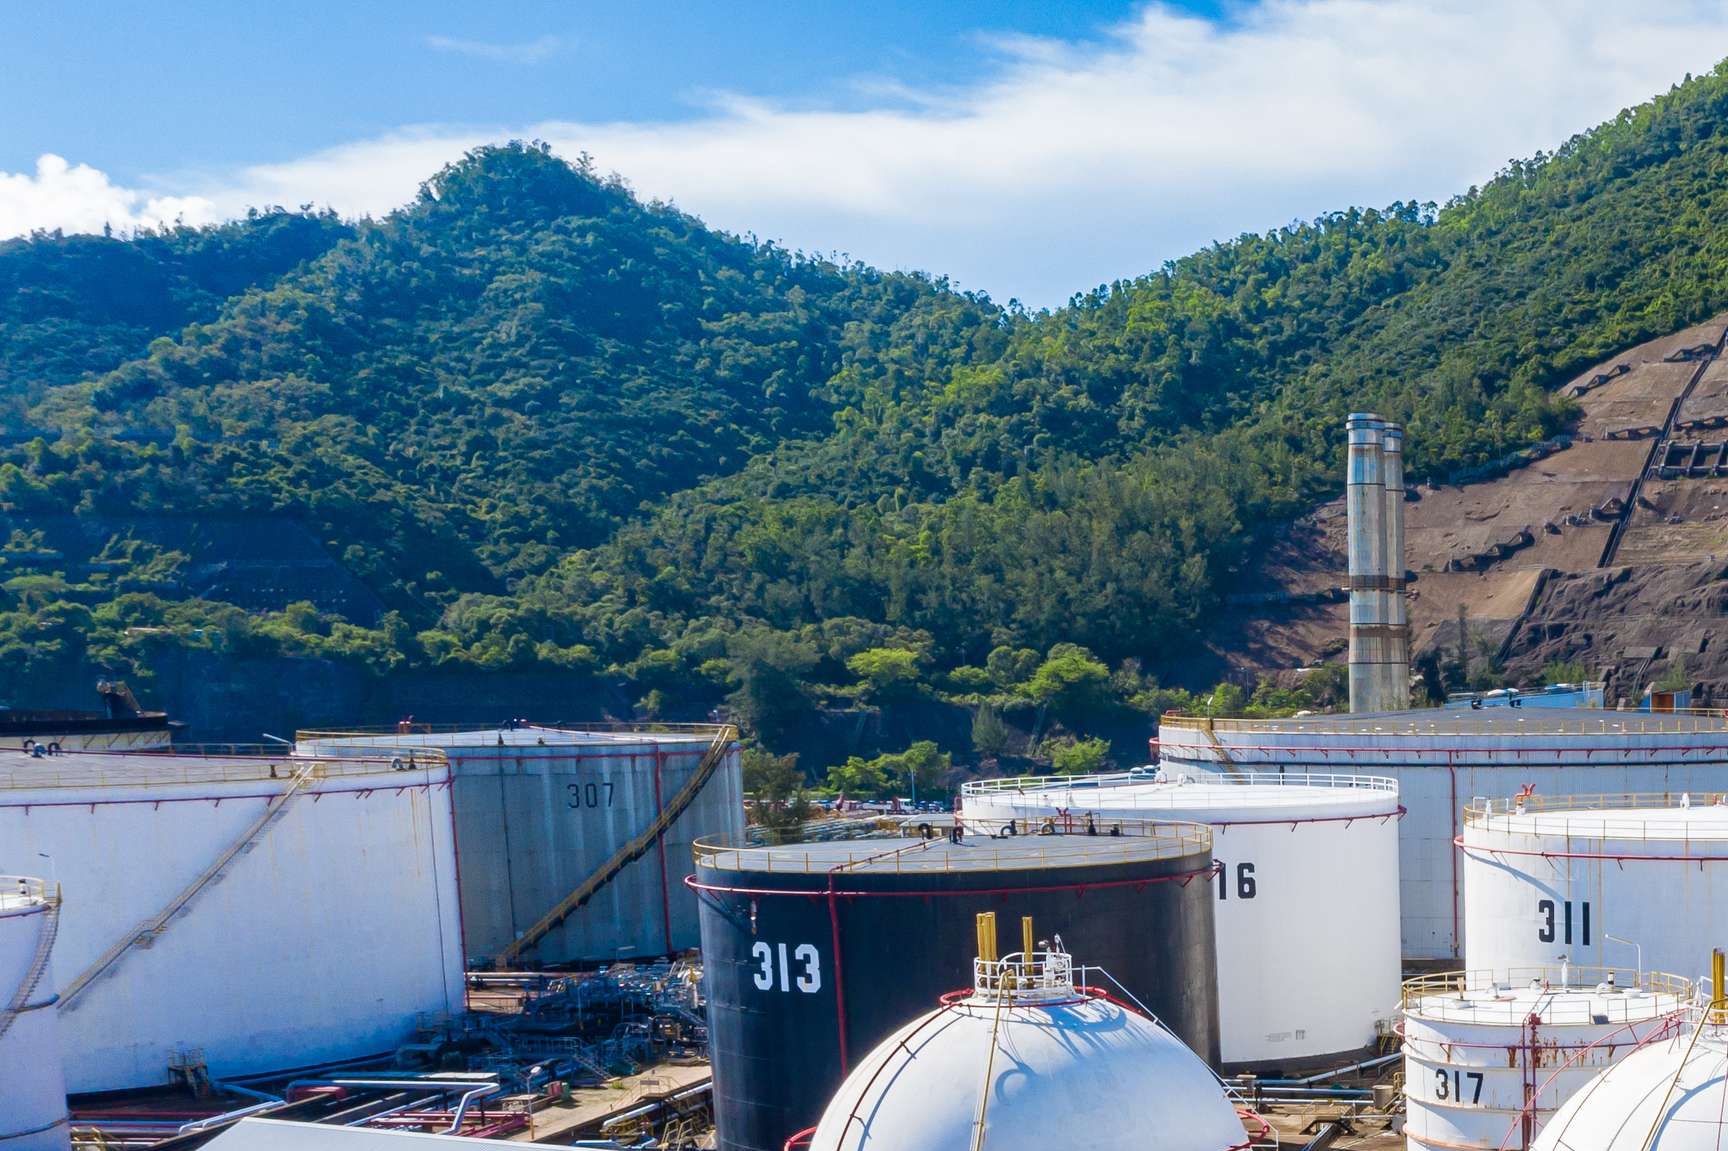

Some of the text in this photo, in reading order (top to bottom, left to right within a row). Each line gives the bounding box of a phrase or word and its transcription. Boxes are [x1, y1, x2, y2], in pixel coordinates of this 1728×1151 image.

[567, 782, 614, 809] 307
[1538, 899, 1590, 946] 311
[752, 941, 822, 994] 313
[1435, 1068, 1484, 1104] 317
